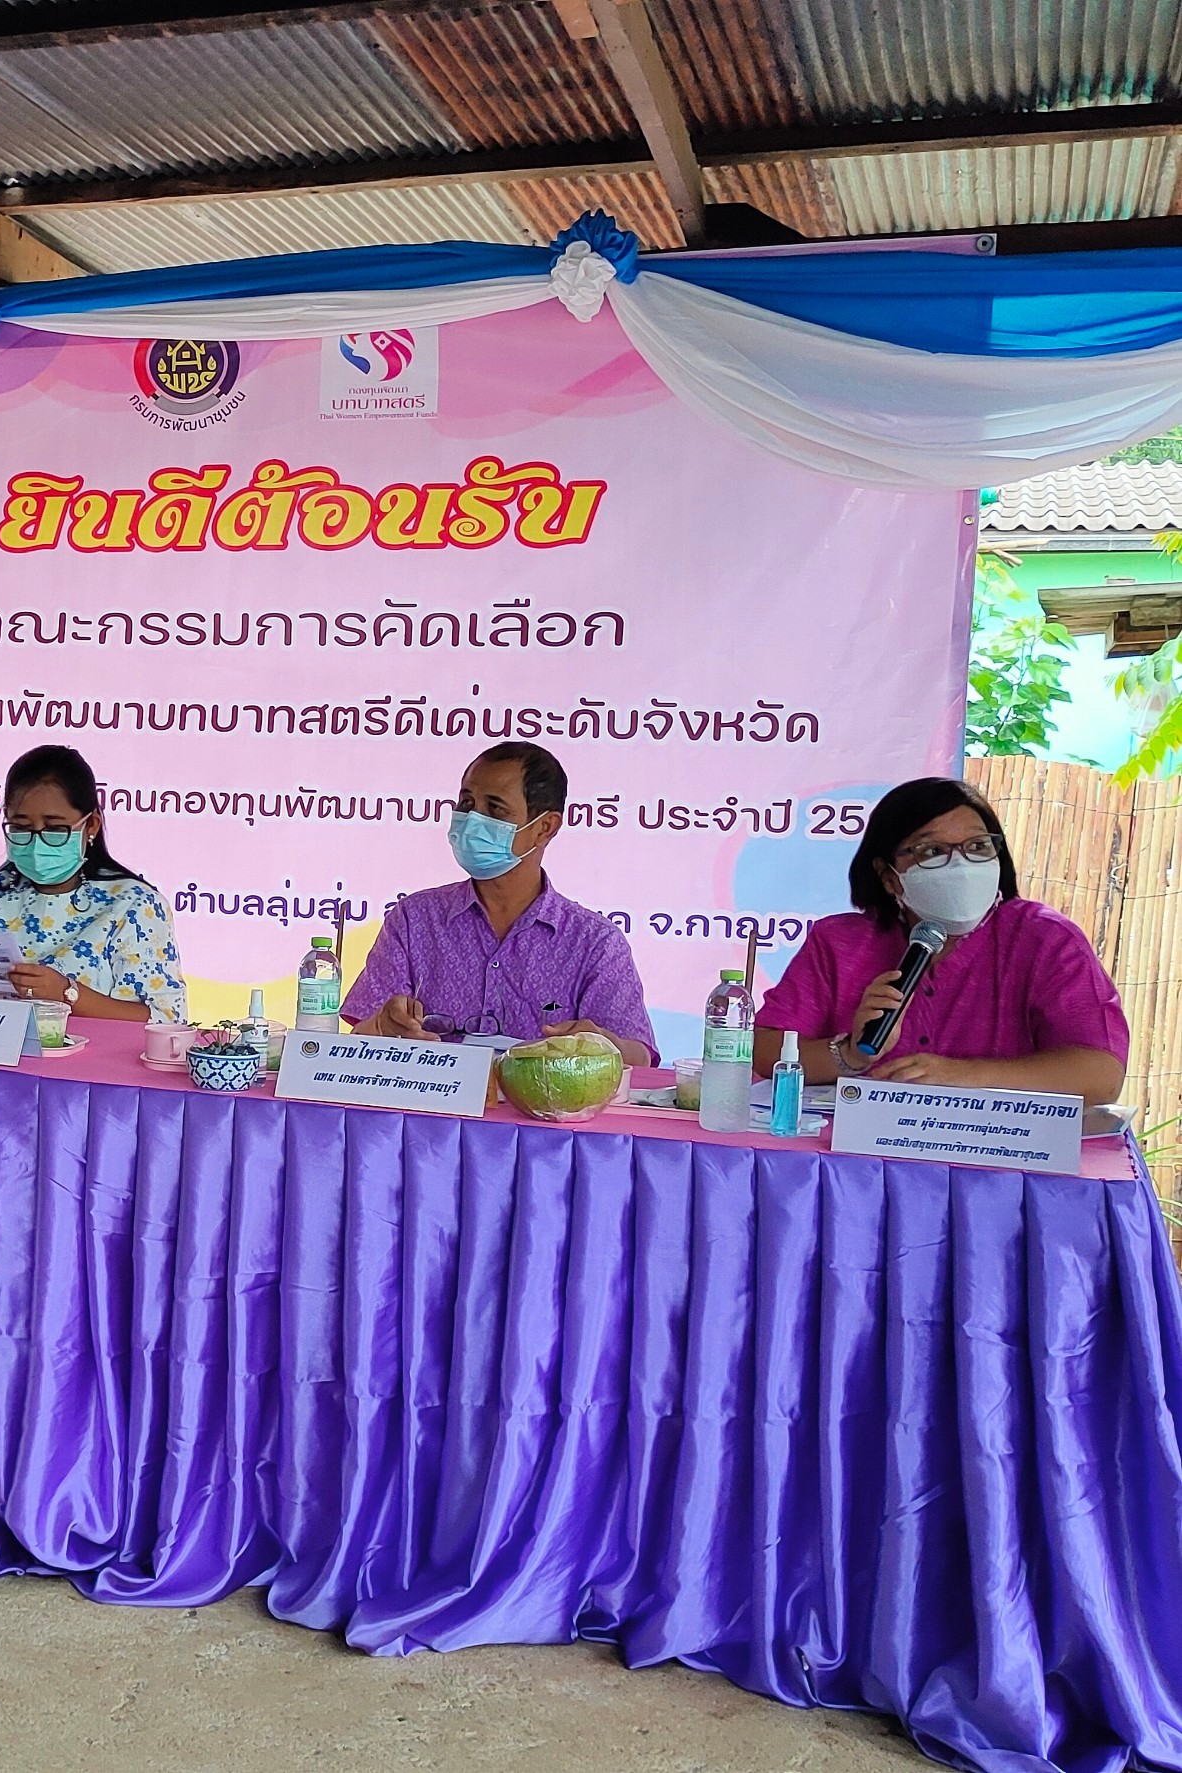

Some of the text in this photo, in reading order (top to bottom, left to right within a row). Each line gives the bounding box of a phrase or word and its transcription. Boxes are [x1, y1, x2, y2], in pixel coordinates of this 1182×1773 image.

[331, 394, 426, 410] บทบาทสตรี
[348, 386, 409, 396] กองทุนพัฒนา
[129, 391, 246, 431] กรมการพัฒนาชุมชน
[364, 412, 414, 420] Empowerment
[638, 796, 793, 833] ประจำปี
[810, 804, 865, 836] 25
[174, 879, 368, 929] ตำบลลุ่มสุ่ม
[313, 1071, 461, 1097] แทน เกษตรจังหวัดกาญจนบุรี
[868, 1088, 1079, 1119] นางสาวอรวรรณ ทรงประกอบ
[897, 1117, 918, 1128] แทน
